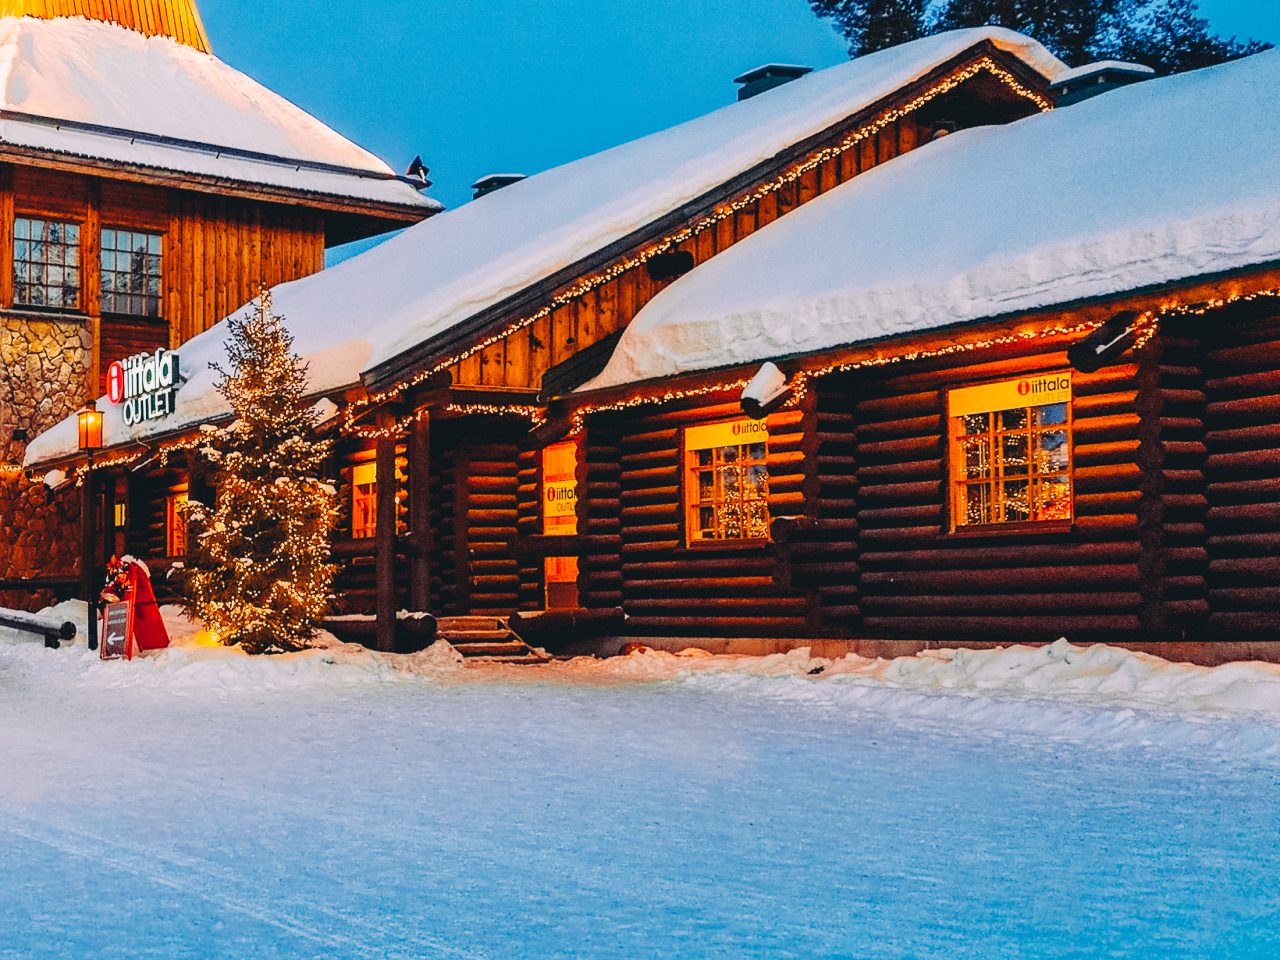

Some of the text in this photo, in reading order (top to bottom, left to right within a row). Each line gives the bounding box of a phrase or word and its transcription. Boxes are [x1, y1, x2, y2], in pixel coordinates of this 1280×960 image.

[123, 349, 173, 399] iittala
[1031, 377, 1069, 393] iittala
[123, 389, 172, 426] OUTLET
[557, 503, 575, 512] OUTL
